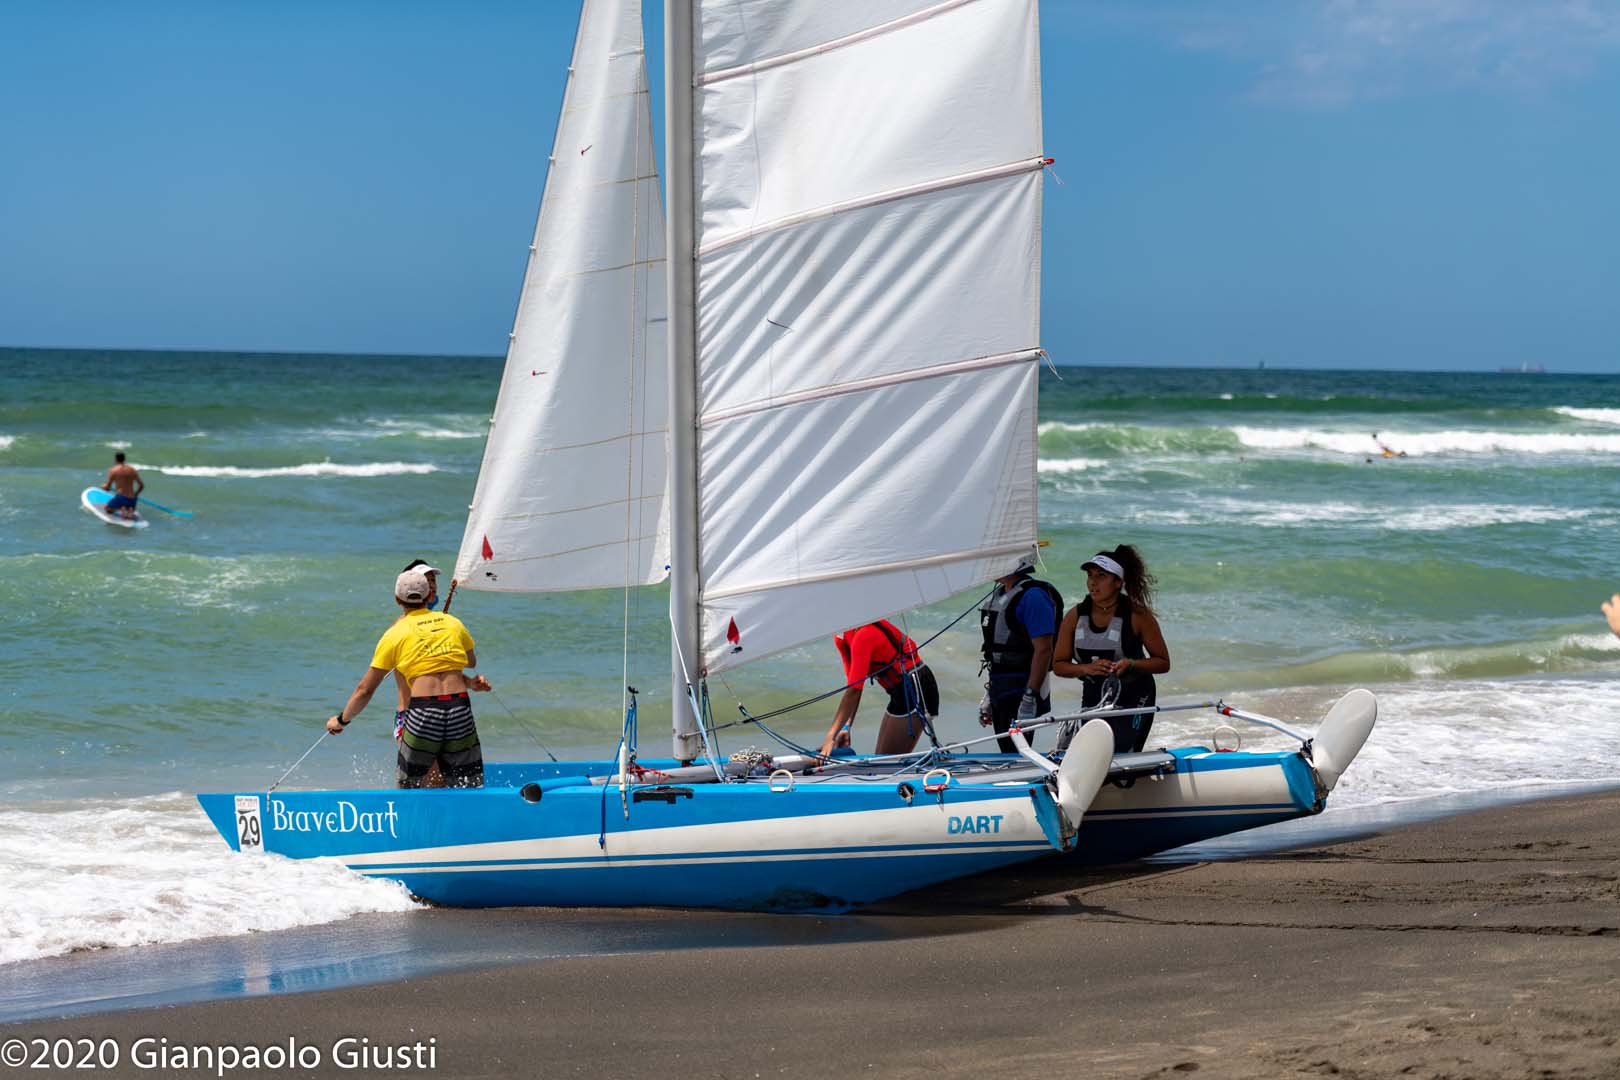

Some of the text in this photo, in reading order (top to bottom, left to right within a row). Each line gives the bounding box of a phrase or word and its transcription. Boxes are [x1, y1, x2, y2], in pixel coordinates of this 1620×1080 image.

[238, 815, 261, 847] 29
[272, 799, 398, 839] BraveDart
[947, 815, 1004, 835] DART
